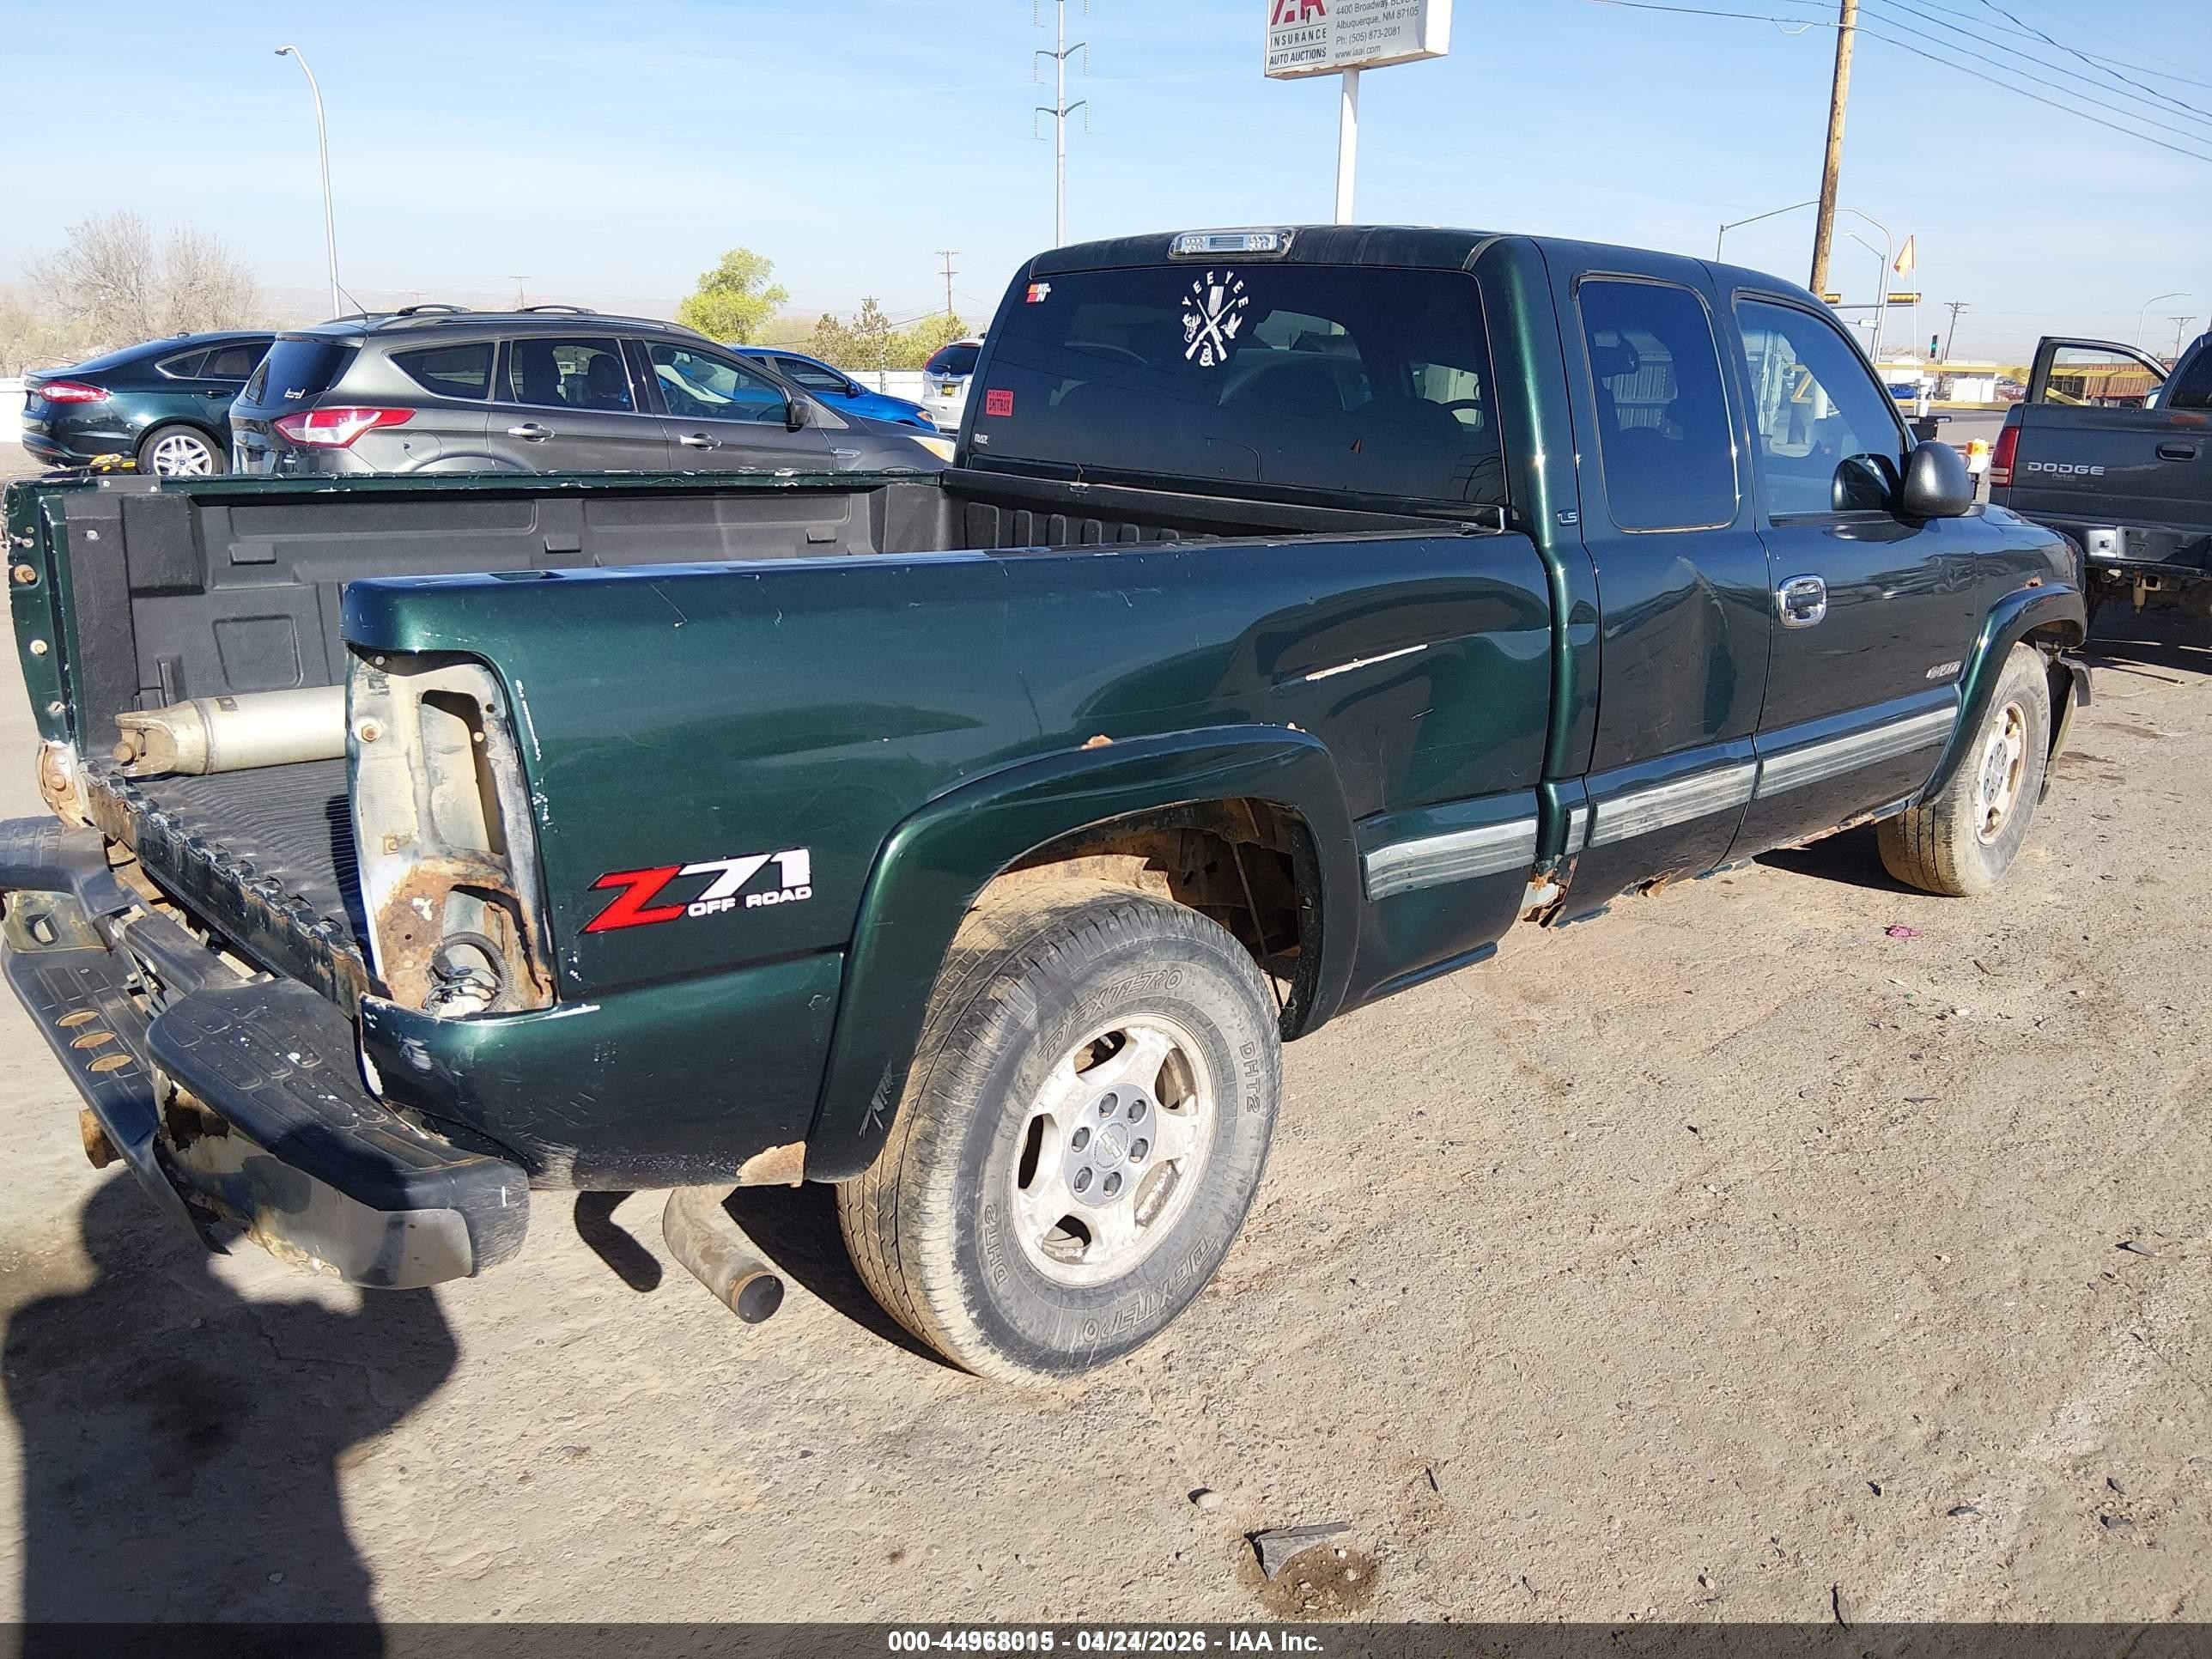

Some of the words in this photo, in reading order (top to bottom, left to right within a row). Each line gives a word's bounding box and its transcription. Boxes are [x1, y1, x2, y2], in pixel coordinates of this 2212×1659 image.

[1336, 4, 1353, 15] 4400
[1354, 0, 1388, 12] Broadway
[1336, 15, 1381, 29] Albuquerque,
[1382, 10, 1395, 21] NM
[1396, 6, 1419, 19] 87105
[1270, 27, 1327, 47] INSURANCE
[1336, 35, 1347, 46] Ph:
[1349, 32, 1367, 46] (505)
[1368, 26, 1401, 41] 873-2081
[1269, 53, 1289, 66] AUTO
[1290, 46, 1327, 63] AUCTIONS
[2027, 461, 2106, 477] DODGE
[579, 847, 811, 933] Z71
[688, 897, 736, 918] OFF
[745, 885, 812, 908] ROAD
